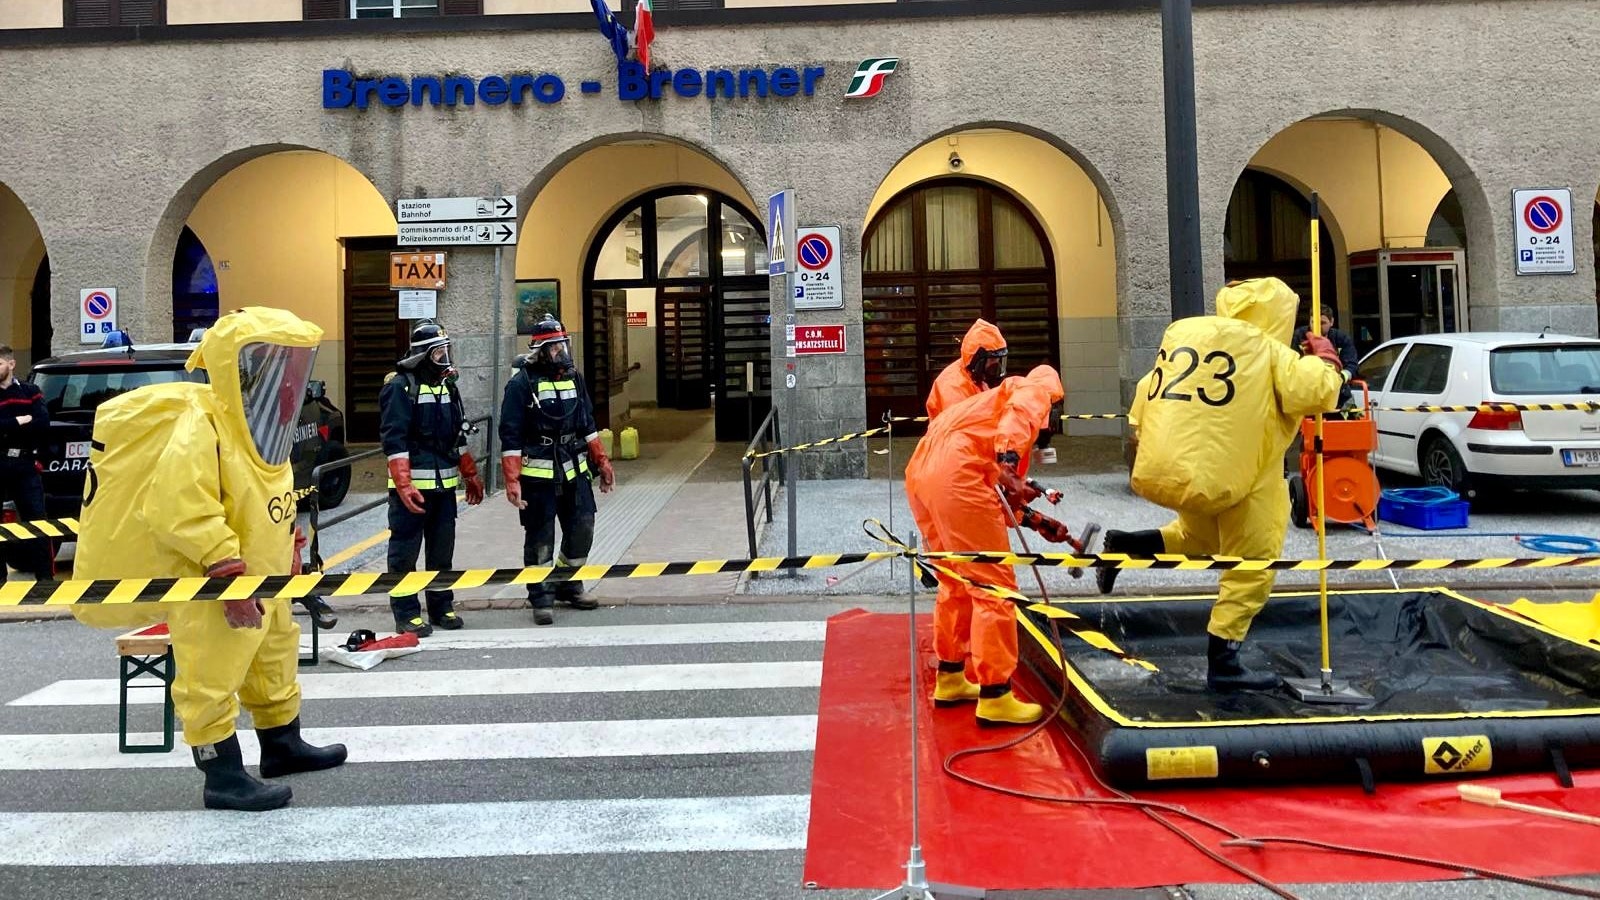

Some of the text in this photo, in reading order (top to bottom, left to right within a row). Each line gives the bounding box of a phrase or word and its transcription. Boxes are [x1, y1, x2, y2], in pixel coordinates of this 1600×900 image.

[322, 69, 565, 109] Brennero
[618, 60, 825, 100] Brenner
[401, 210, 431, 218] Bahnhof
[394, 263, 443, 279] TAXI
[1147, 346, 1236, 407] 623
[68, 443, 84, 456] CC
[1585, 451, 1600, 462] 38
[1453, 739, 1484, 770] vetter
